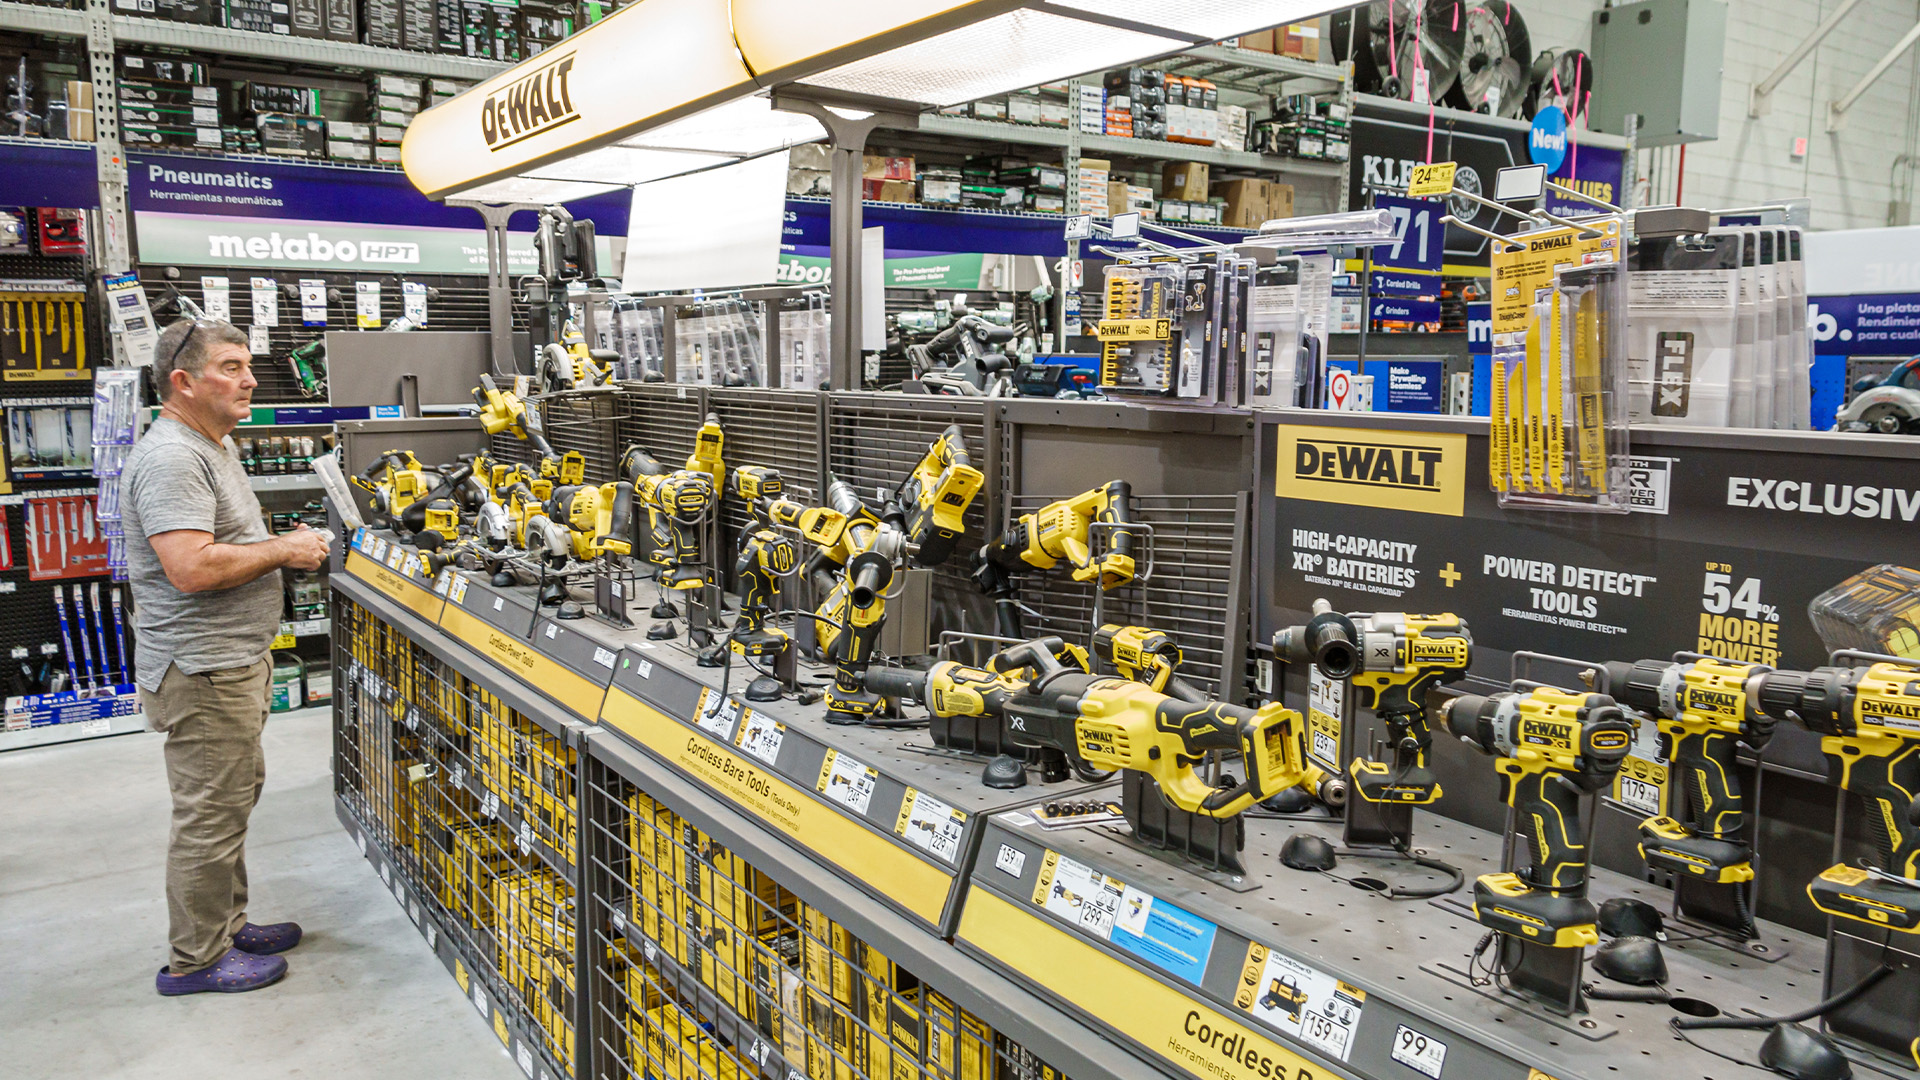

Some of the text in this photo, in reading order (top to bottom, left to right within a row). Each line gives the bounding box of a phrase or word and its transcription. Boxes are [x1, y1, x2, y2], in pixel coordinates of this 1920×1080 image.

[1533, 128, 1564, 150] New!
[149, 164, 273, 190] Pneumatics
[150, 189, 284, 207] Herramientas neumáticas
[1554, 177, 1613, 204] VALUES
[1390, 206, 1429, 262] 71
[1531, 235, 1573, 252] DEWALT
[208, 233, 415, 262] metabo HPT
[1386, 280, 1405, 288] Corded
[1386, 306, 1409, 316] Grinders
[1858, 303, 1883, 314] Una
[1101, 325, 1130, 335] DEWALT
[1858, 331, 1888, 342] para
[1255, 338, 1271, 389] FLEX
[1660, 340, 1686, 407] FLEX
[1292, 528, 1418, 563] HIGH-CAPACITY
[1483, 554, 1556, 585] POWER
[1705, 562, 1732, 573] UP TO
[1304, 574, 1331, 586] BATERÍAS
[1343, 582, 1352, 590] DE
[1352, 583, 1367, 592] ALTA
[1530, 588, 1597, 619] TOOLS
[1502, 608, 1558, 625] HERRAMIENTAS
[1558, 617, 1586, 630] POWER
[1699, 613, 1779, 648] MORE
[1375, 648, 1390, 657] XR
[1414, 645, 1456, 654] DEWALT
[1689, 689, 1738, 708] DEWALT
[1010, 715, 1026, 731] XR
[1524, 719, 1572, 739] DEWALT
[1084, 730, 1113, 743] DEWALT
[687, 737, 723, 769] Cordless
[723, 758, 744, 782] Bare
[745, 770, 771, 797] Tools
[1184, 1010, 1288, 1080] Cordless
[1168, 1037, 1236, 1080] Herramientas
